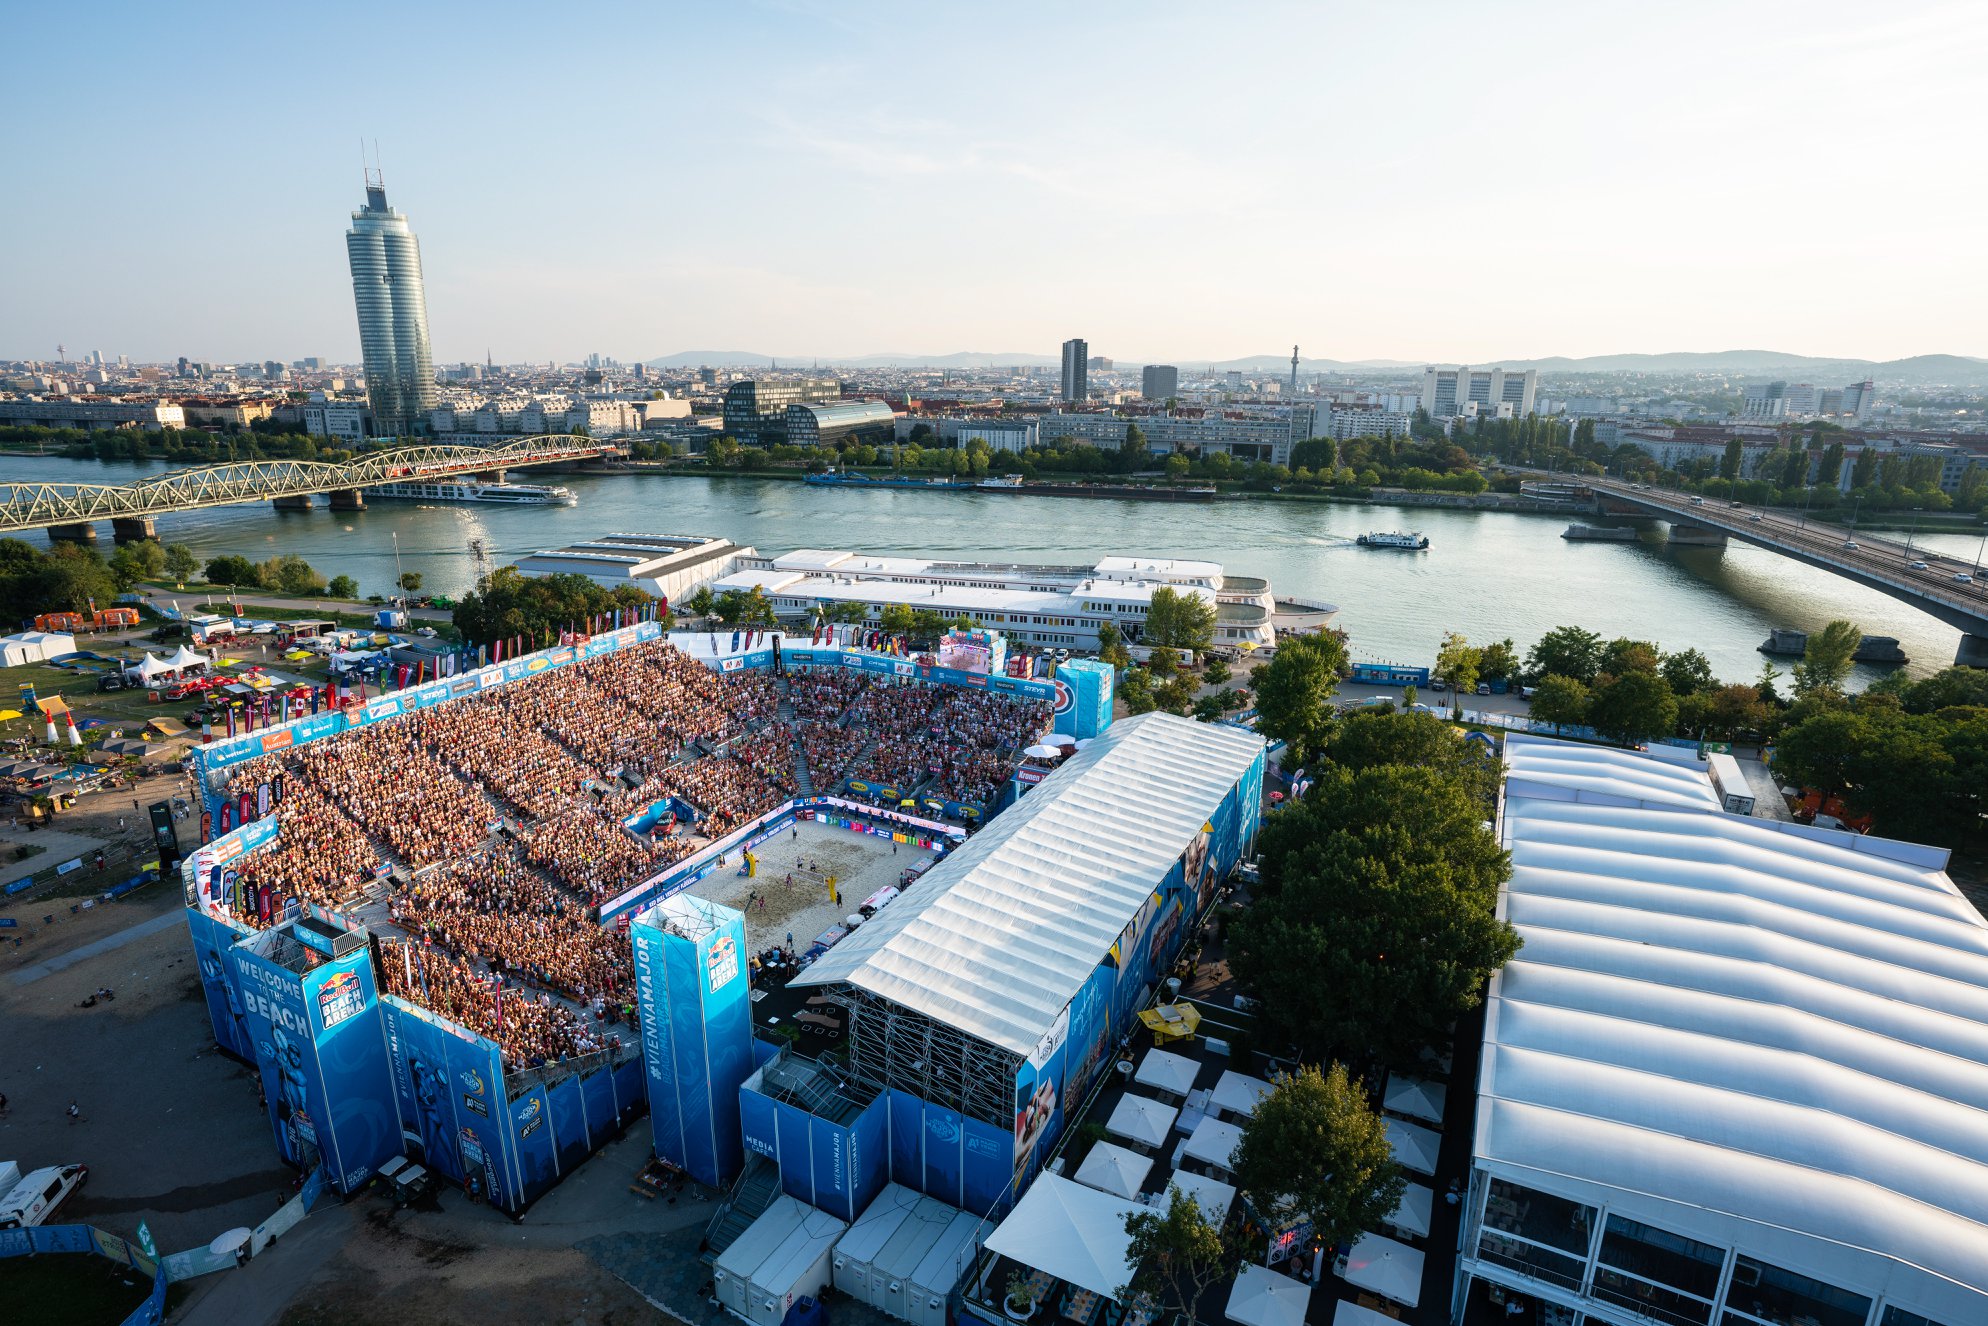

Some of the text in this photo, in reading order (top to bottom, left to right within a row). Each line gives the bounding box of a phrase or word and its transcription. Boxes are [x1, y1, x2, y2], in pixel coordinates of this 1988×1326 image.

[422, 688, 447, 700] STEYR
[1023, 685, 1046, 694] STEYR
[225, 747, 252, 759] wetter.tv
[265, 738, 292, 750] Austrian
[1018, 770, 1041, 782] Kronen
[648, 899, 657, 908] RED
[656, 894, 665, 904] BULL
[710, 956, 736, 979] BEACH
[237, 957, 301, 1000] WELCOME
[711, 967, 738, 991] ARENA
[257, 983, 285, 1004] TO THE
[320, 978, 360, 1004] Red Bull
[321, 989, 361, 1017] BEACH
[636, 936, 663, 1080] #VIENNAMAJOR
[243, 989, 310, 1039] BEACH
[325, 1001, 364, 1028] ARENA
[387, 1013, 409, 1099] #VIENNAMAJOR
[746, 1135, 774, 1153] MEDIA
[968, 1138, 980, 1149] A1
[347, 1165, 365, 1179] BEACH
